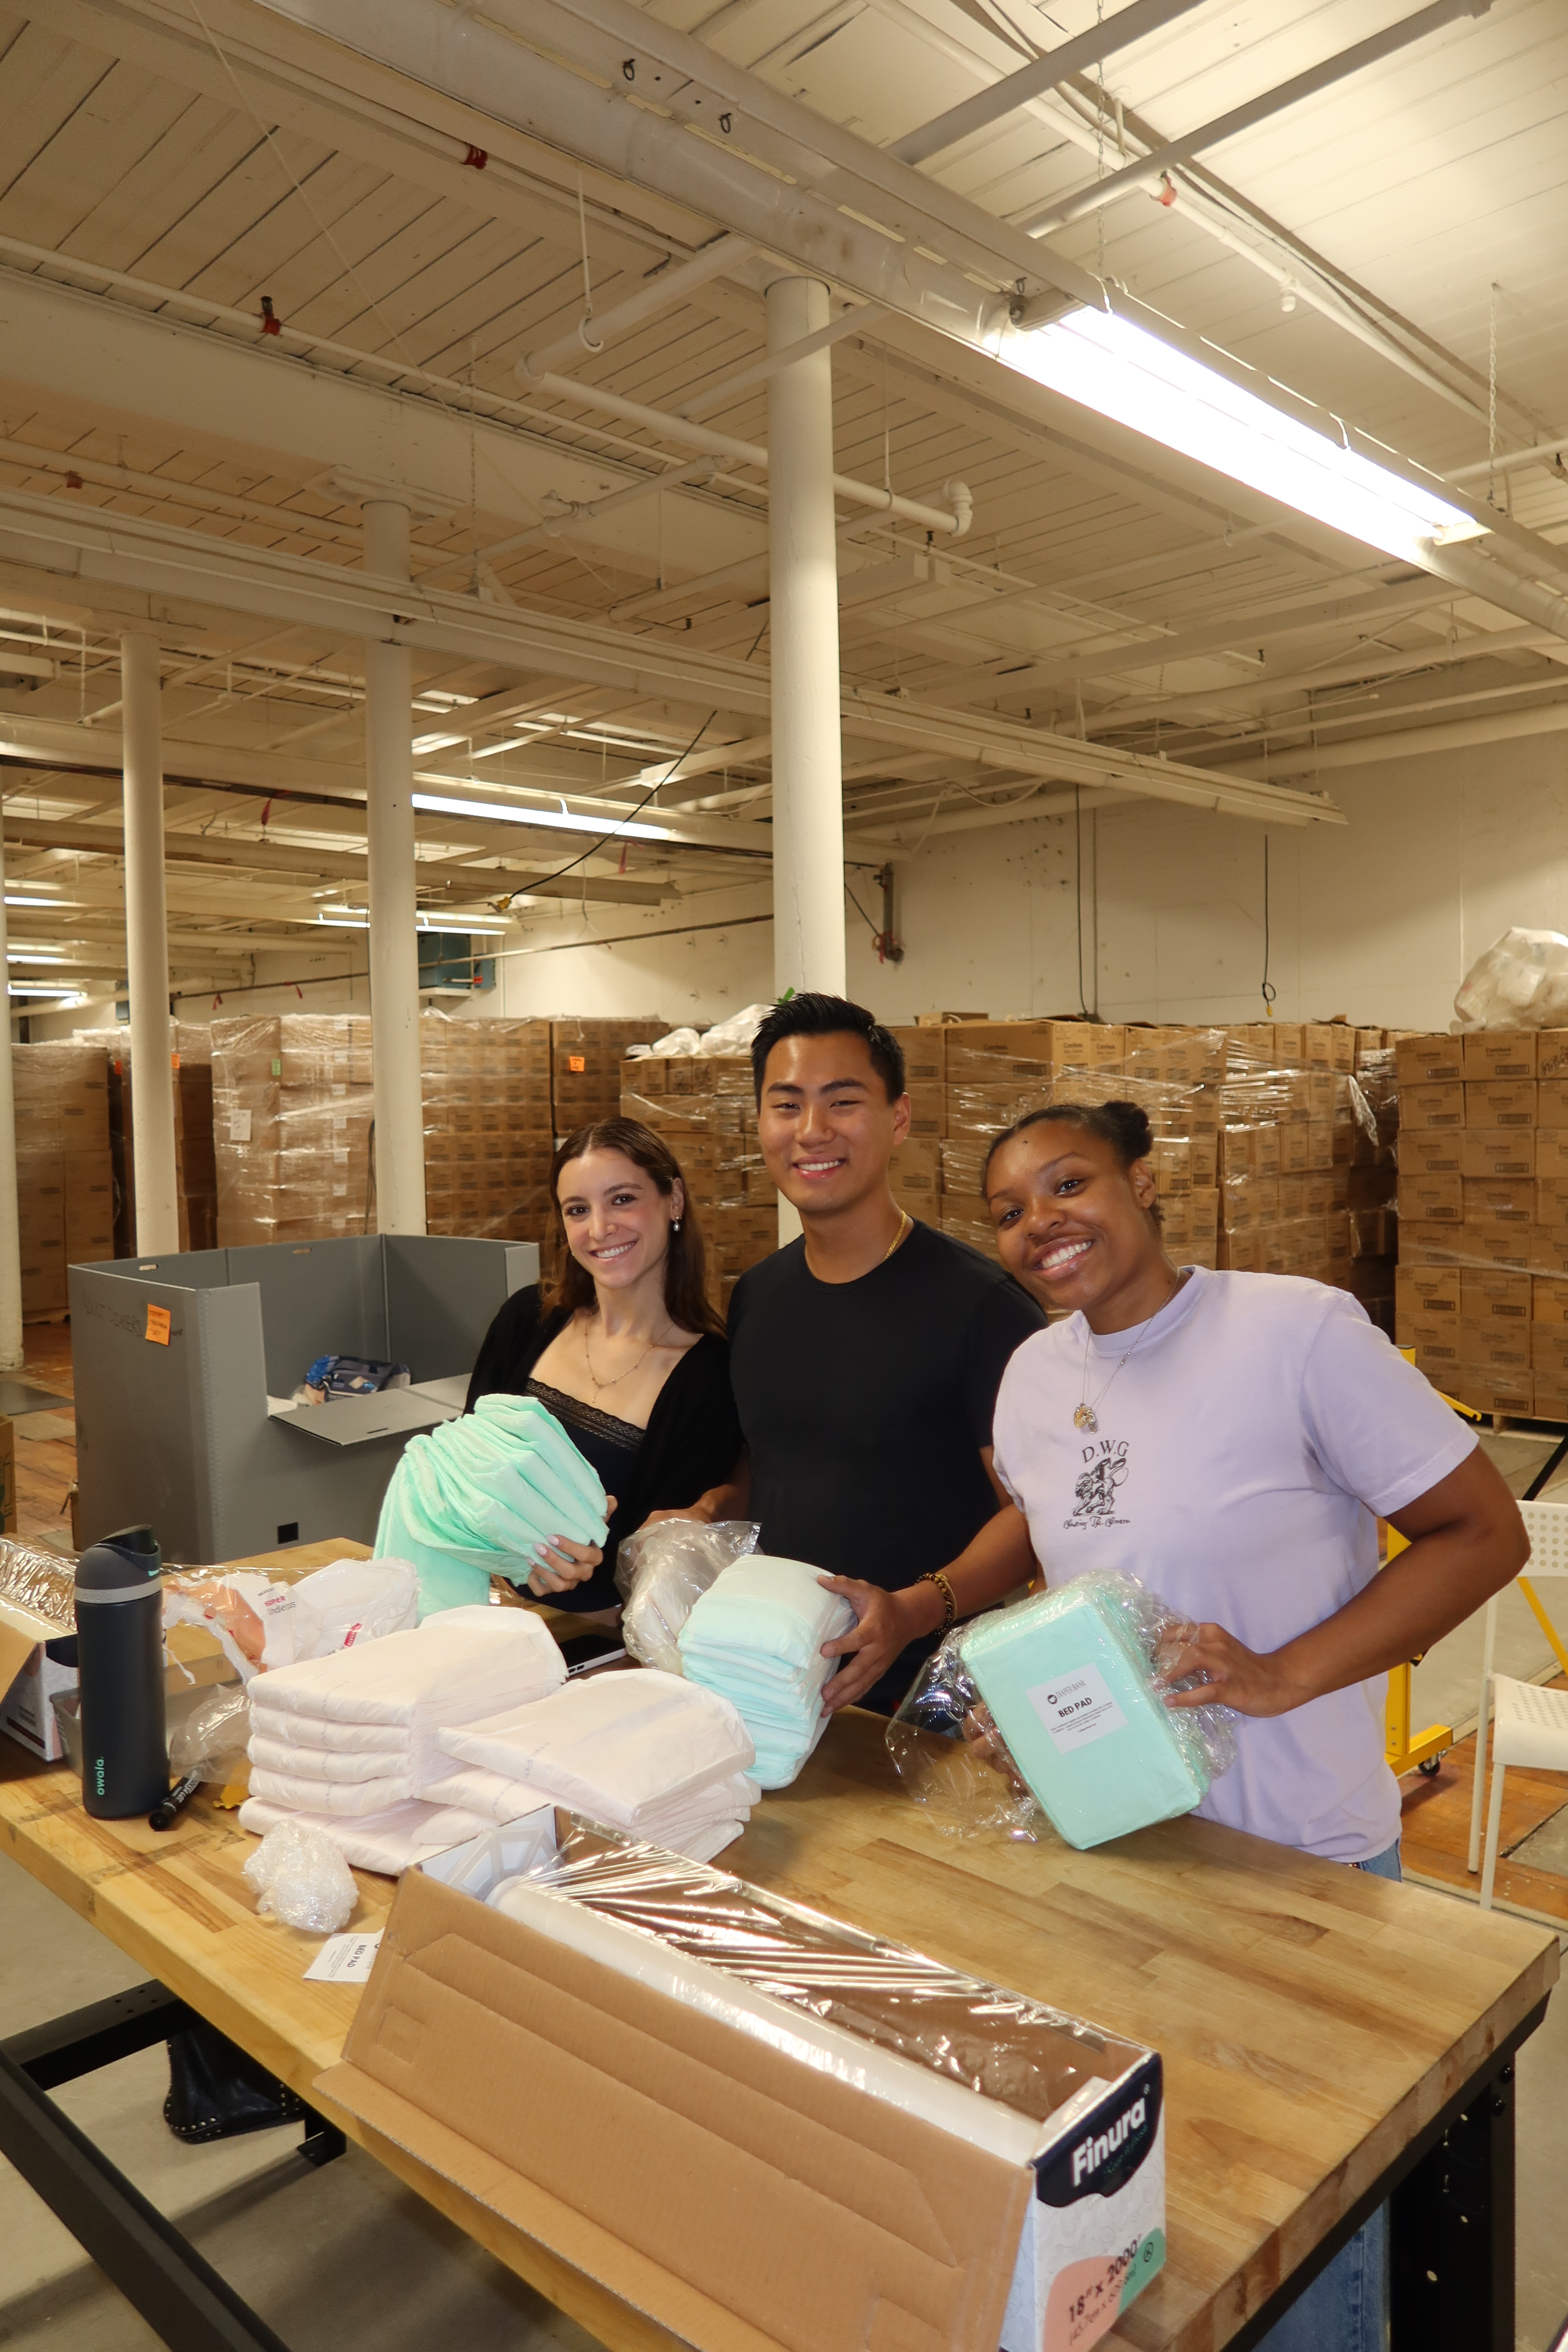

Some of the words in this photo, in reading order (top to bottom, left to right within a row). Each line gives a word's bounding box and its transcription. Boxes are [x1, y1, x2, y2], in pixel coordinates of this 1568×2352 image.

[1090, 1516, 1103, 1528] The
[264, 1596, 286, 1607] SUPER
[1056, 1686, 1074, 1699] DIAPER
[1072, 1679, 1086, 1690] BANK
[1058, 1705, 1075, 1718] BED
[1075, 1697, 1092, 1709] PAD
[355, 1945, 367, 1954] BED
[347, 1956, 360, 1967] PAD
[1073, 2097, 1145, 2187] Finura
